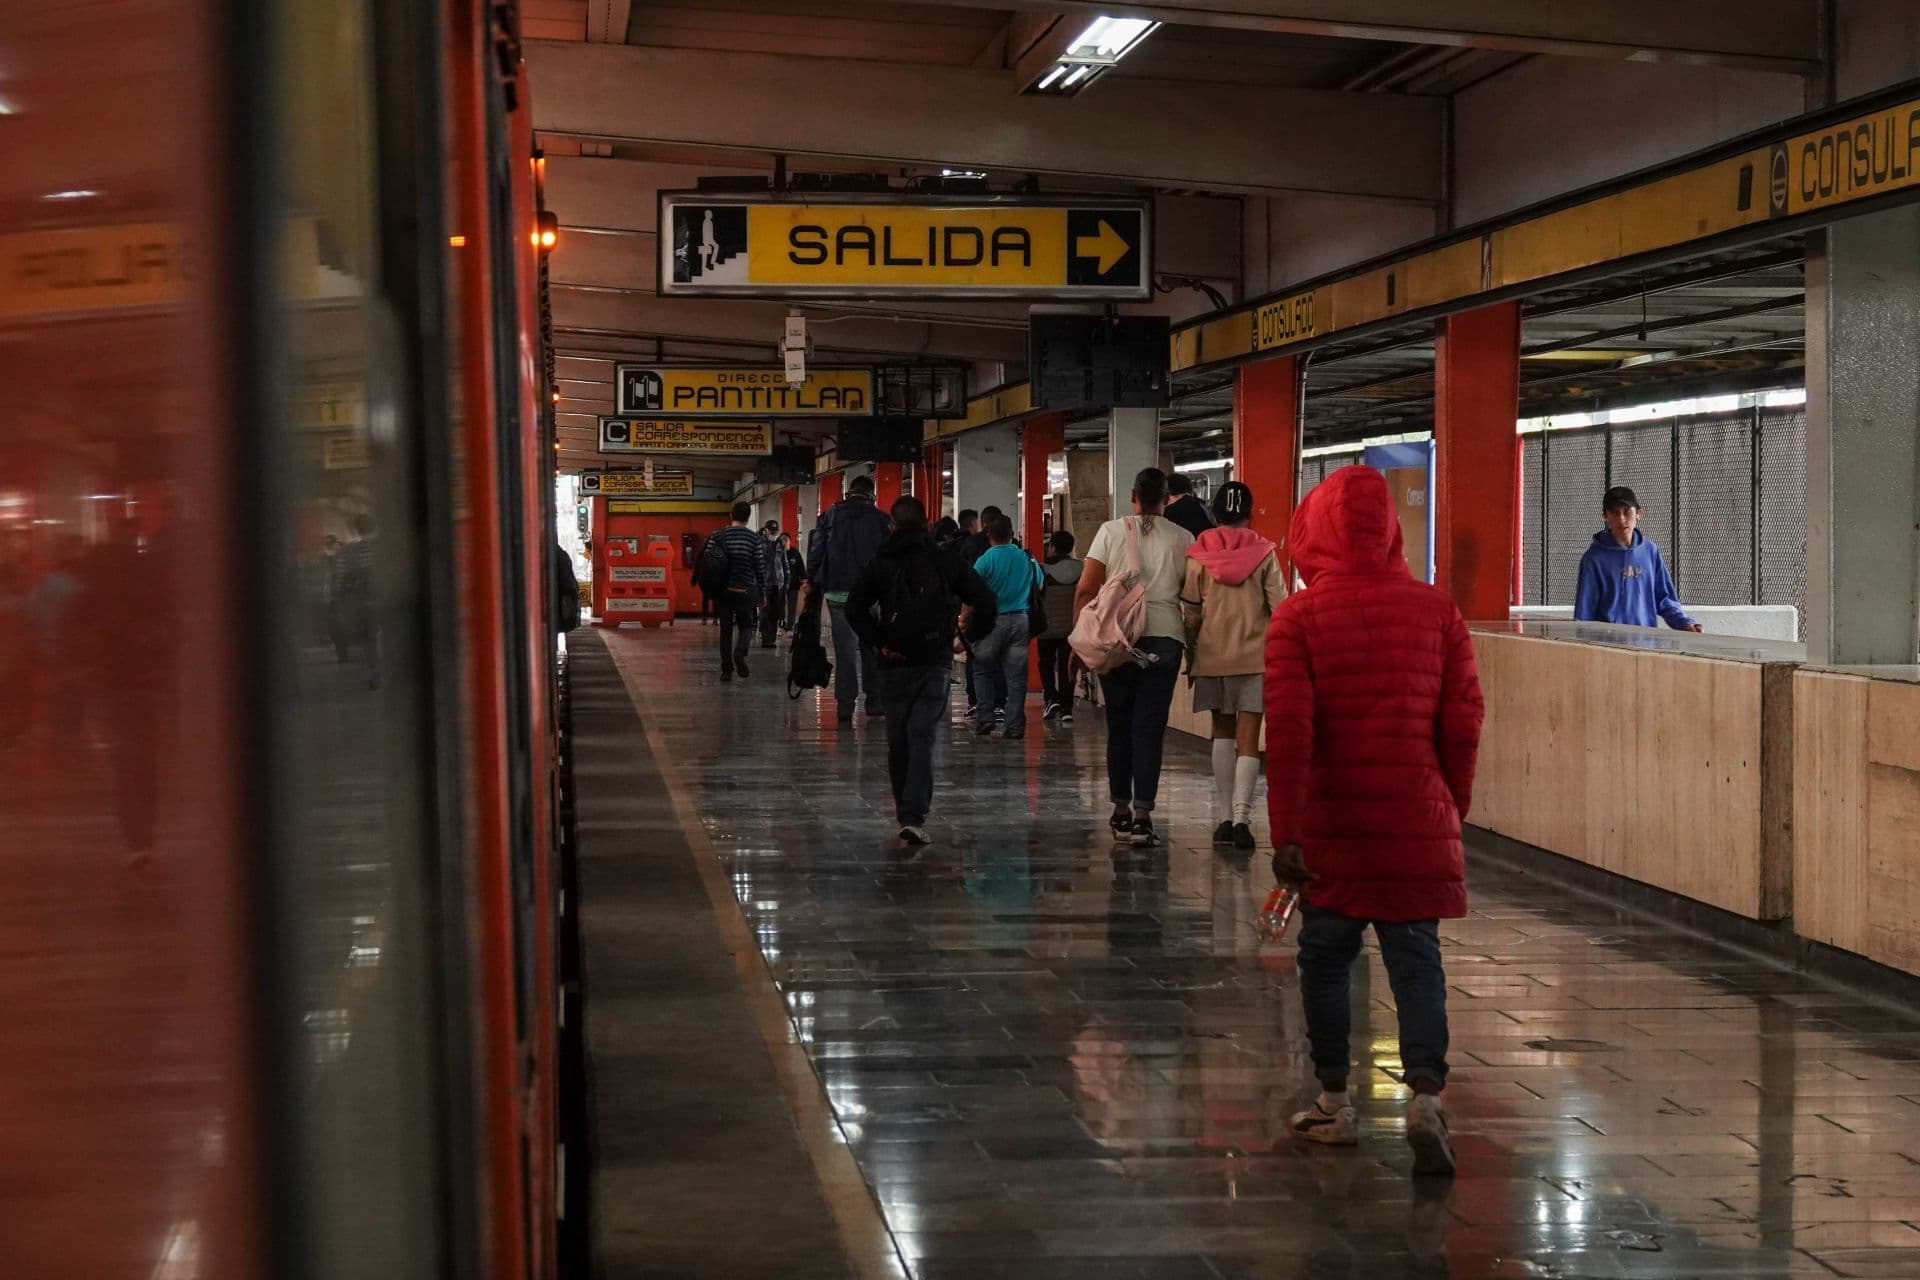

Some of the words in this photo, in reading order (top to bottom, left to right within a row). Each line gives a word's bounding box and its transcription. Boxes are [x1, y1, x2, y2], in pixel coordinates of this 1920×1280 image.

[788, 225, 1031, 267] SALIDA
[1262, 295, 1313, 344] CONSULADO
[717, 373, 814, 384] DIRECCN
[673, 385, 864, 408] PANTITLAN
[607, 422, 626, 441] C
[635, 422, 684, 432] SALIDA
[635, 431, 765, 443] CORRESPONDENCIA
